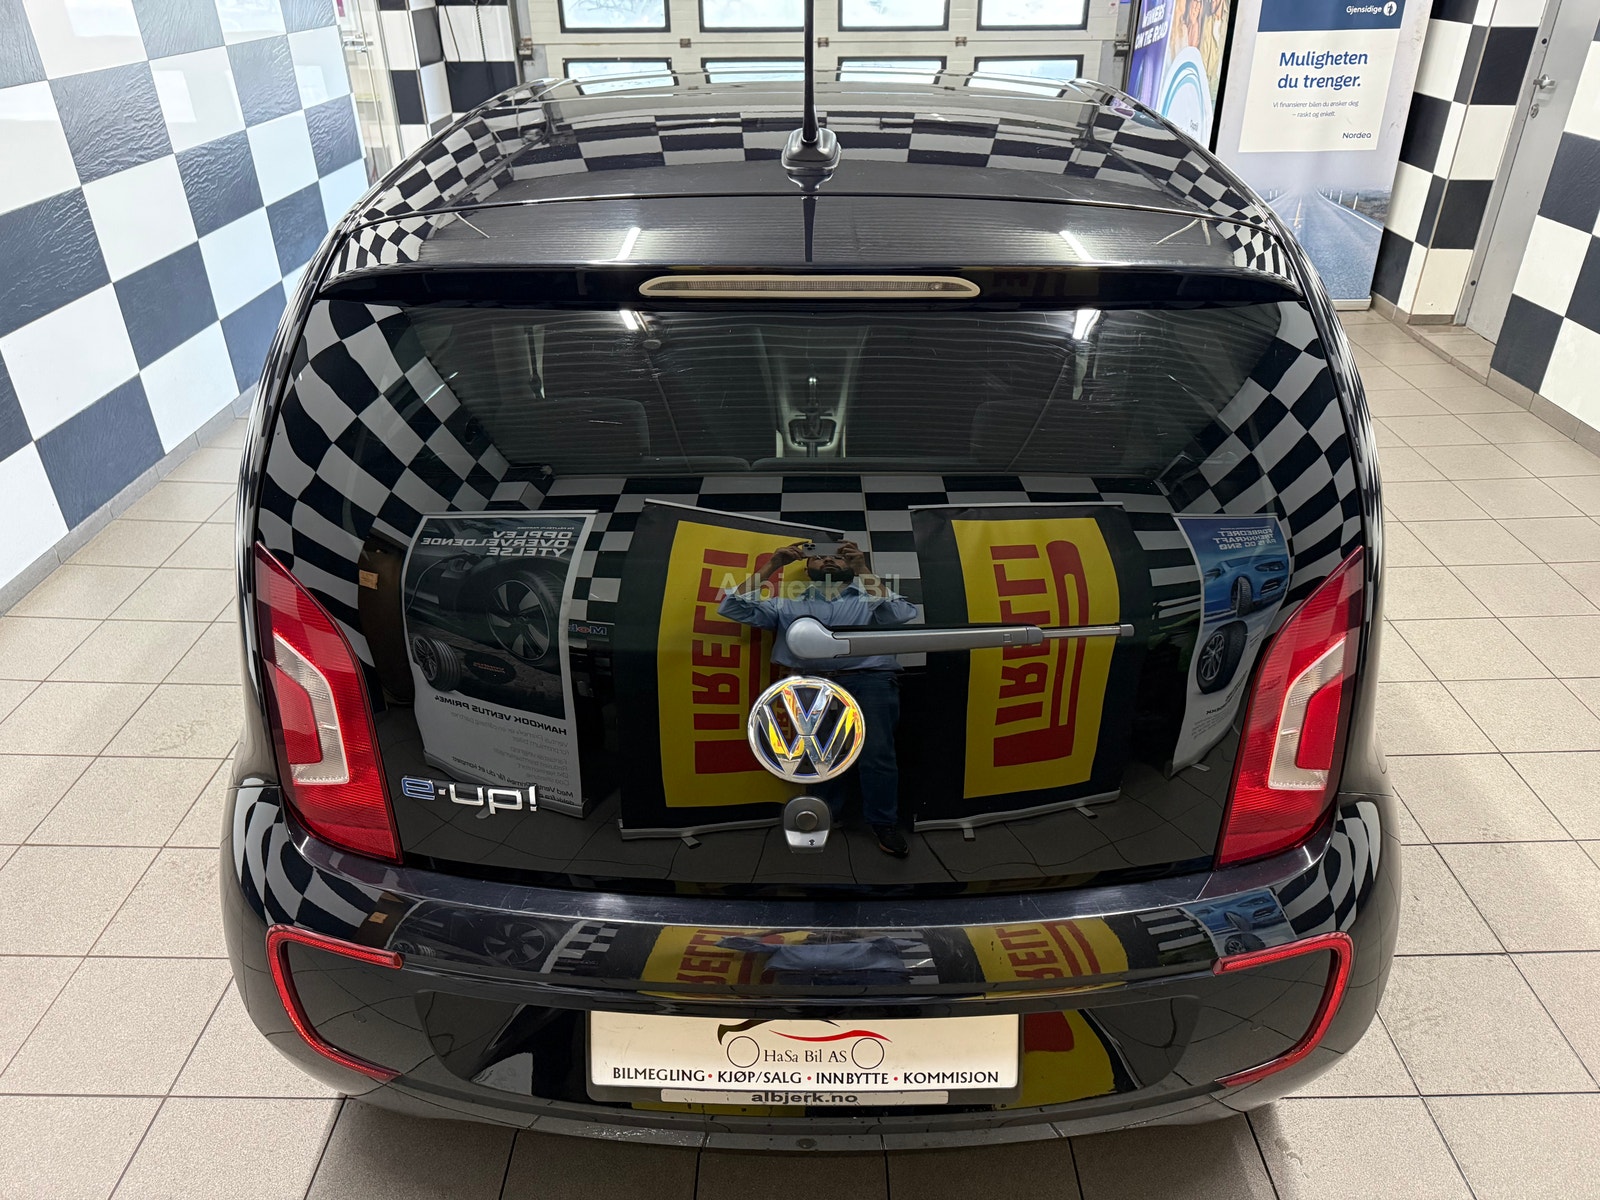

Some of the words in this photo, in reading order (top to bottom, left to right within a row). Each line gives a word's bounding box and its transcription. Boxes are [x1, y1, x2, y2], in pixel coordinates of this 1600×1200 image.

[1345, 5, 1383, 15] Gjensidige
[1279, 50, 1369, 70] Muligheten
[1277, 73, 1299, 89] du
[1303, 74, 1361, 91] trenger.
[1342, 132, 1372, 140] Nordea
[401, 775, 539, 816] e-up!
[763, 1049, 800, 1063] HaSa
[804, 1048, 823, 1063] Bil
[828, 1049, 848, 1063] AS
[612, 1067, 706, 1083] BILMEGLING
[717, 1070, 803, 1084] KJØP/SALG
[815, 1071, 890, 1085] INNBYTTE
[903, 1070, 999, 1085] KOMMISJON
[750, 1090, 859, 1105] albjerk.no
